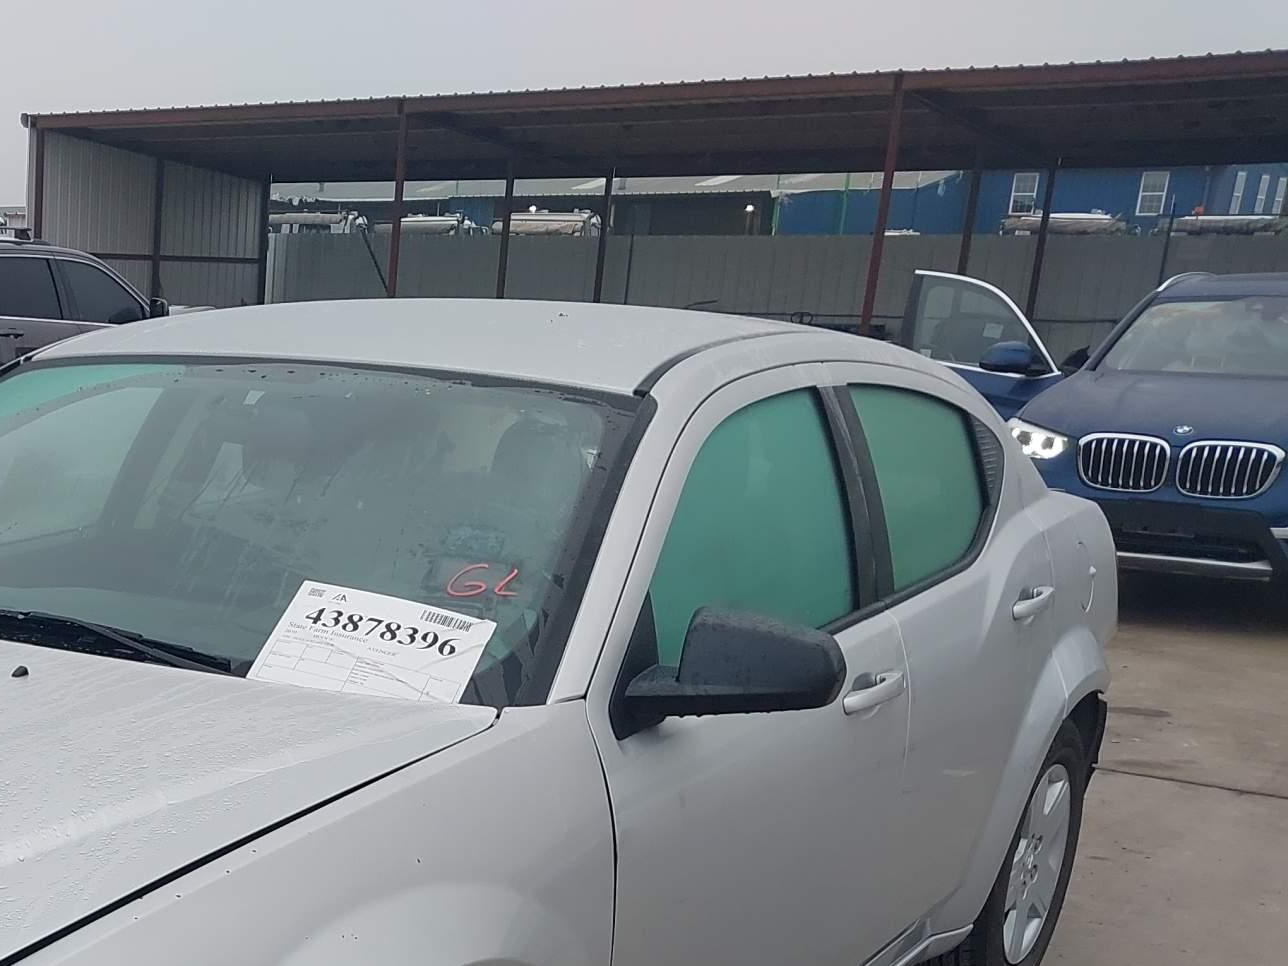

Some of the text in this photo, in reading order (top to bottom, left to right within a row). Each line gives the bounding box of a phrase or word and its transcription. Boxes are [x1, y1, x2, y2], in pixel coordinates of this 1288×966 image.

[288, 621, 309, 631] State
[309, 625, 329, 635] Farm
[330, 630, 369, 644] Insurance
[305, 607, 462, 657] 43878396
